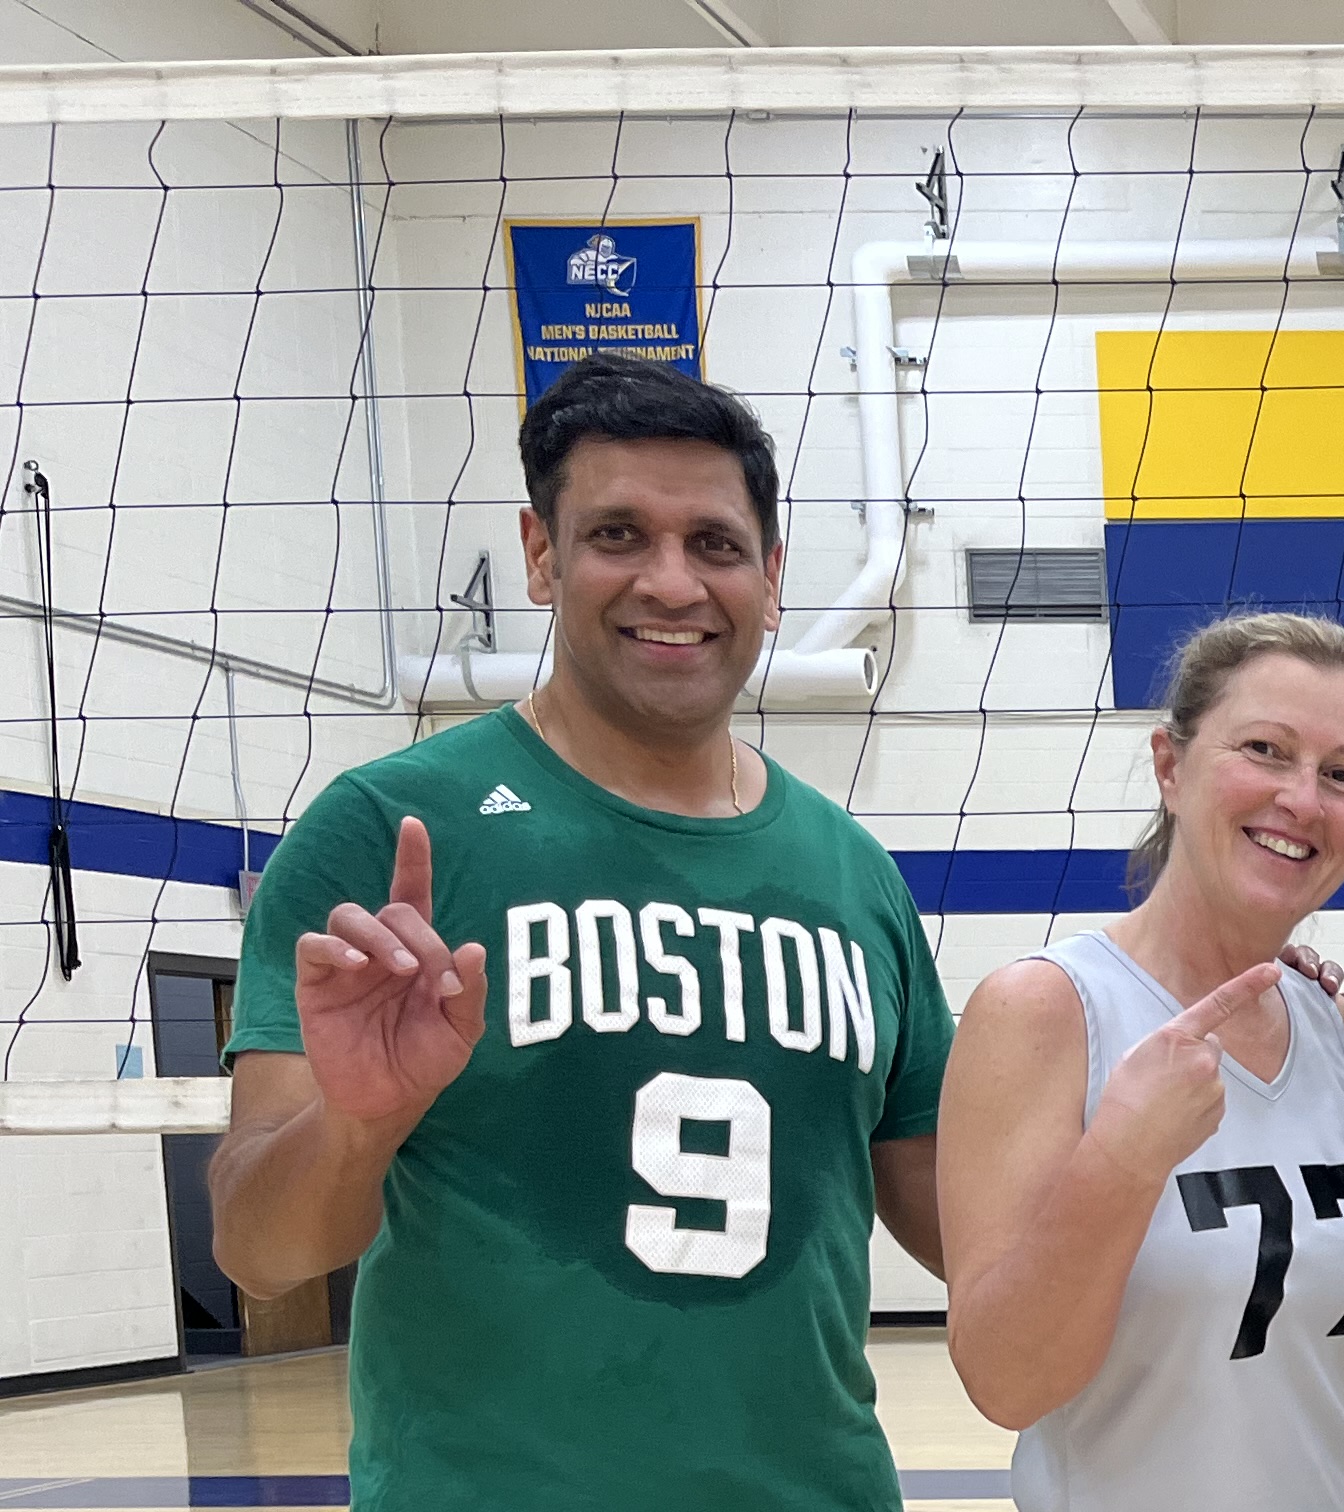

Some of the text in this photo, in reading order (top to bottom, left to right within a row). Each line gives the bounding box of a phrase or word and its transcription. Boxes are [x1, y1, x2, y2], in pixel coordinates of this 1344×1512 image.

[571, 265, 619, 280] NECC
[585, 303, 631, 318] NJCAA
[541, 323, 679, 340] MEN'S BASKETBALL
[479, 801, 531, 815] adidas
[507, 899, 876, 1074] BOSTON
[625, 1071, 771, 1279] 9
